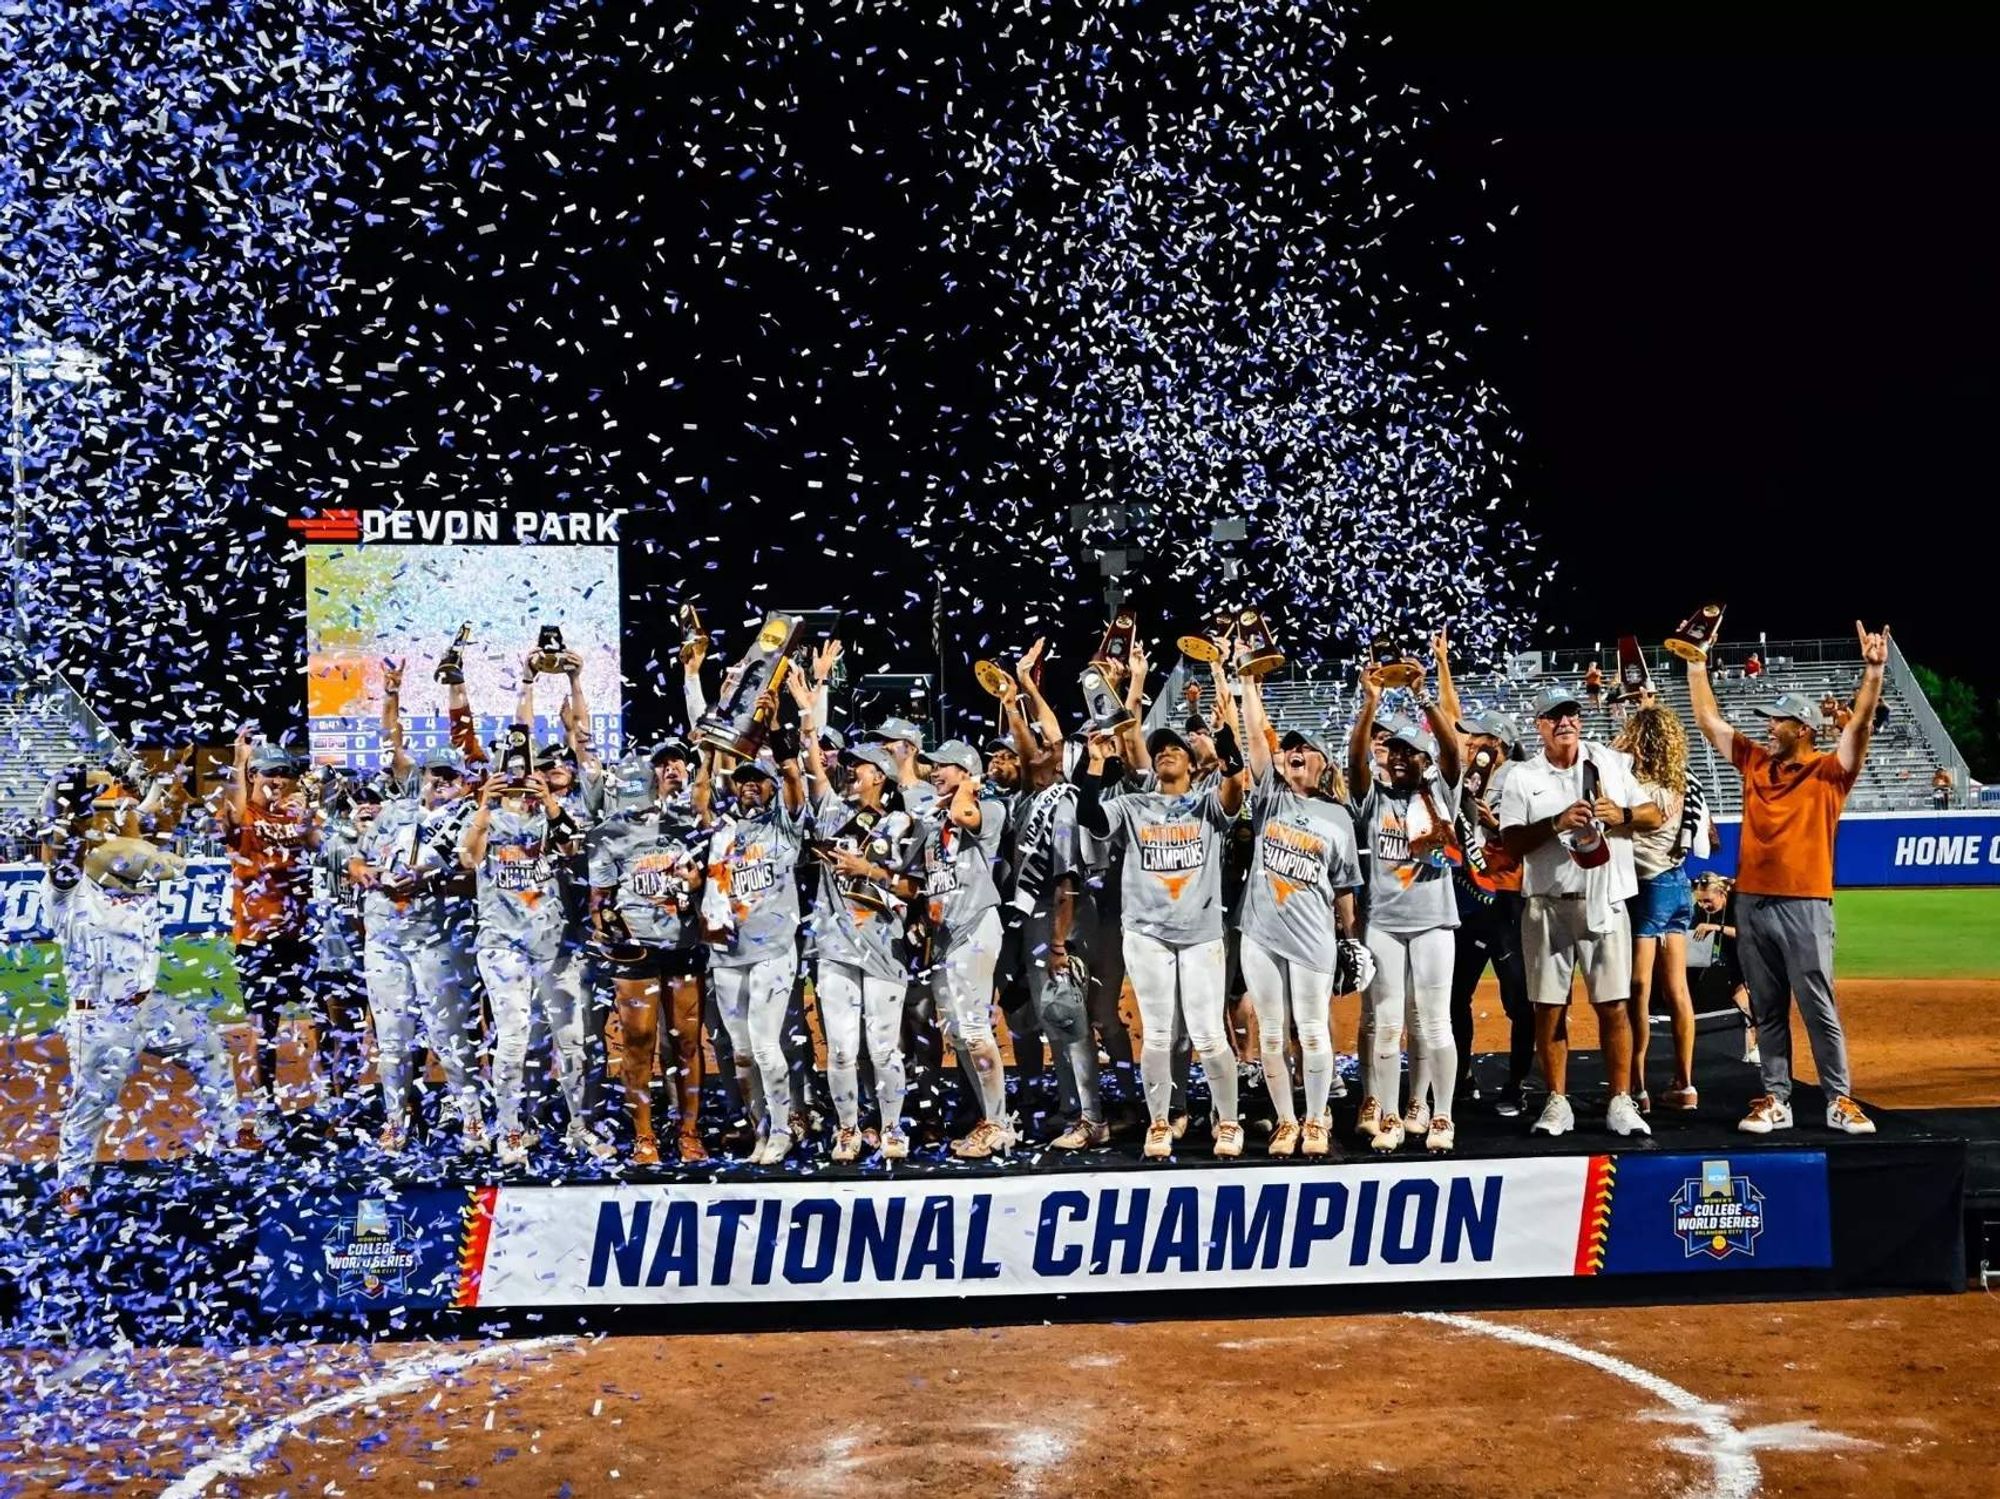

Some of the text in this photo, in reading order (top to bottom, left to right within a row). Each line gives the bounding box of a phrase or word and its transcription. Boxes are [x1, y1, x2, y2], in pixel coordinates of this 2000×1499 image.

[363, 510, 620, 542] DEVON PARK
[253, 819, 305, 838] TEXA
[1142, 842, 1204, 870] CHAMPIONS
[1895, 835, 1982, 866] HOME
[1694, 1203, 1743, 1217] COLLEGE
[588, 1175, 1503, 1287] NATIONAL CHAMPION
[1677, 1215, 1760, 1231] WORLD SERIES
[347, 1242, 397, 1256] COLLEGE
